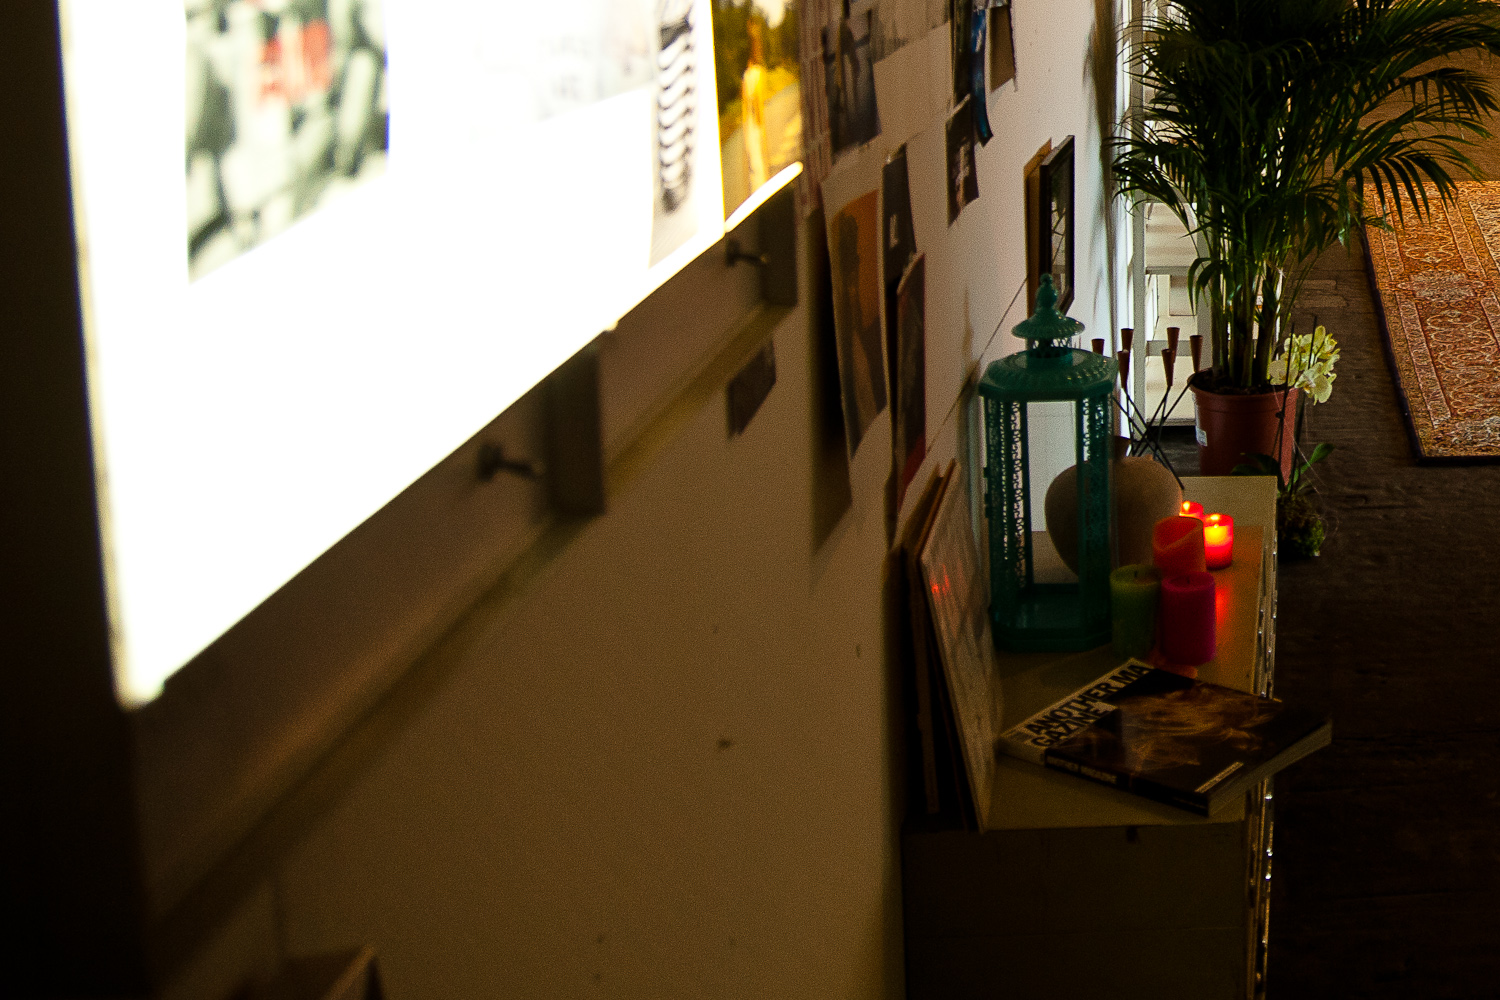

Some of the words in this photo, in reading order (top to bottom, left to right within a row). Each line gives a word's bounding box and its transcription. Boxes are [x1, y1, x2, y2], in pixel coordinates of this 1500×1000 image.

[1025, 683, 1116, 735] ANOTHER
[1111, 664, 1152, 686] MA
[1031, 707, 1110, 747] GAZINE
